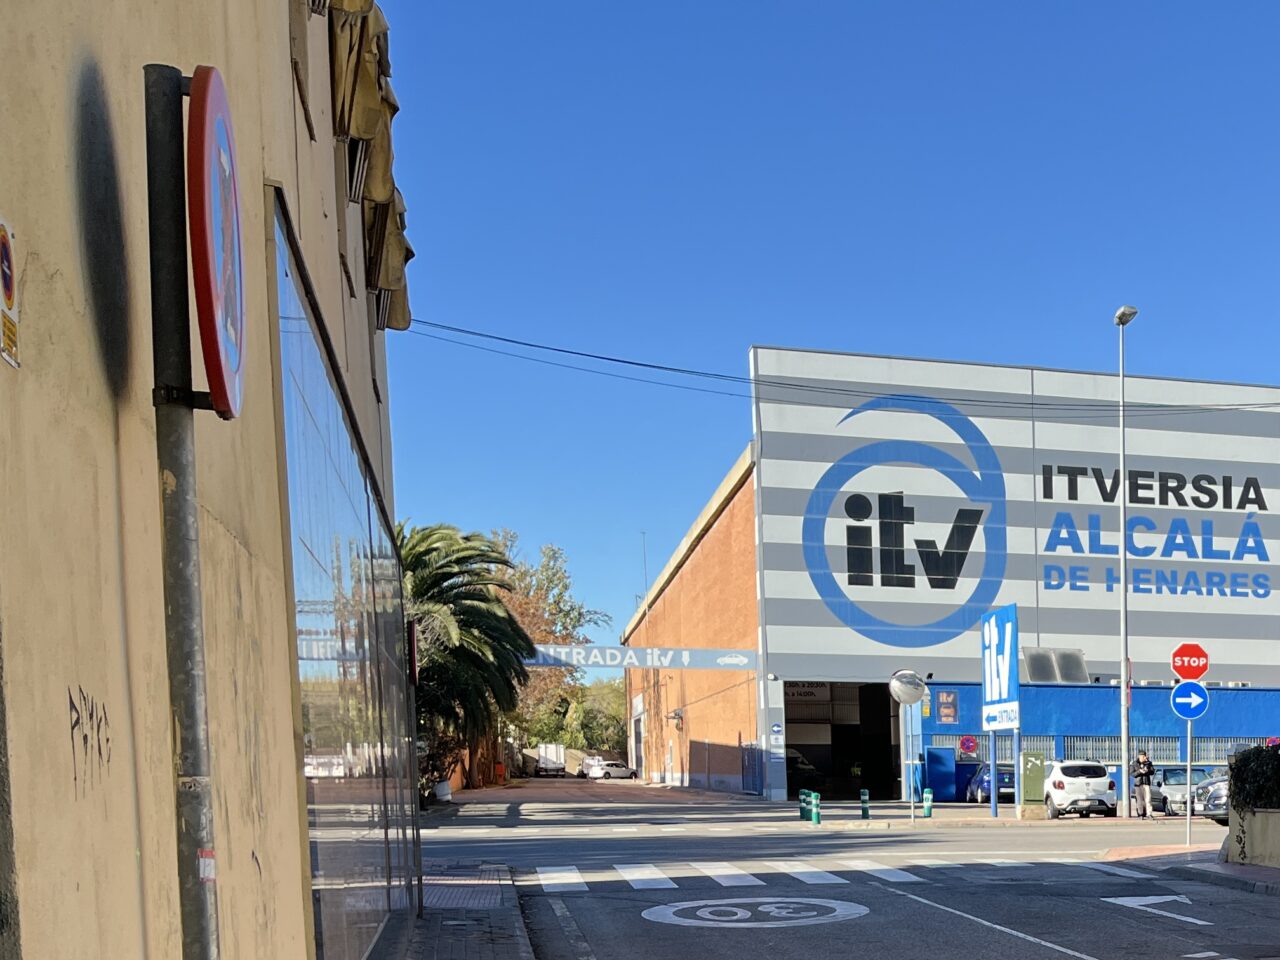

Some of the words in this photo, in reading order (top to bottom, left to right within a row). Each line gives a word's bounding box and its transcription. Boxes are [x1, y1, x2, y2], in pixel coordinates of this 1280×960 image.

[1042, 464, 1268, 511] ITVERSIA
[844, 491, 984, 590] itv
[1043, 512, 1270, 562] ALCALÁ
[1043, 564, 1090, 592] DE
[1105, 567, 1271, 599] HENARES
[523, 647, 639, 666] NTRADA
[646, 647, 673, 666] itv
[983, 614, 1012, 702] itv
[1174, 656, 1207, 667] STOP
[696, 903, 818, 921] 30
